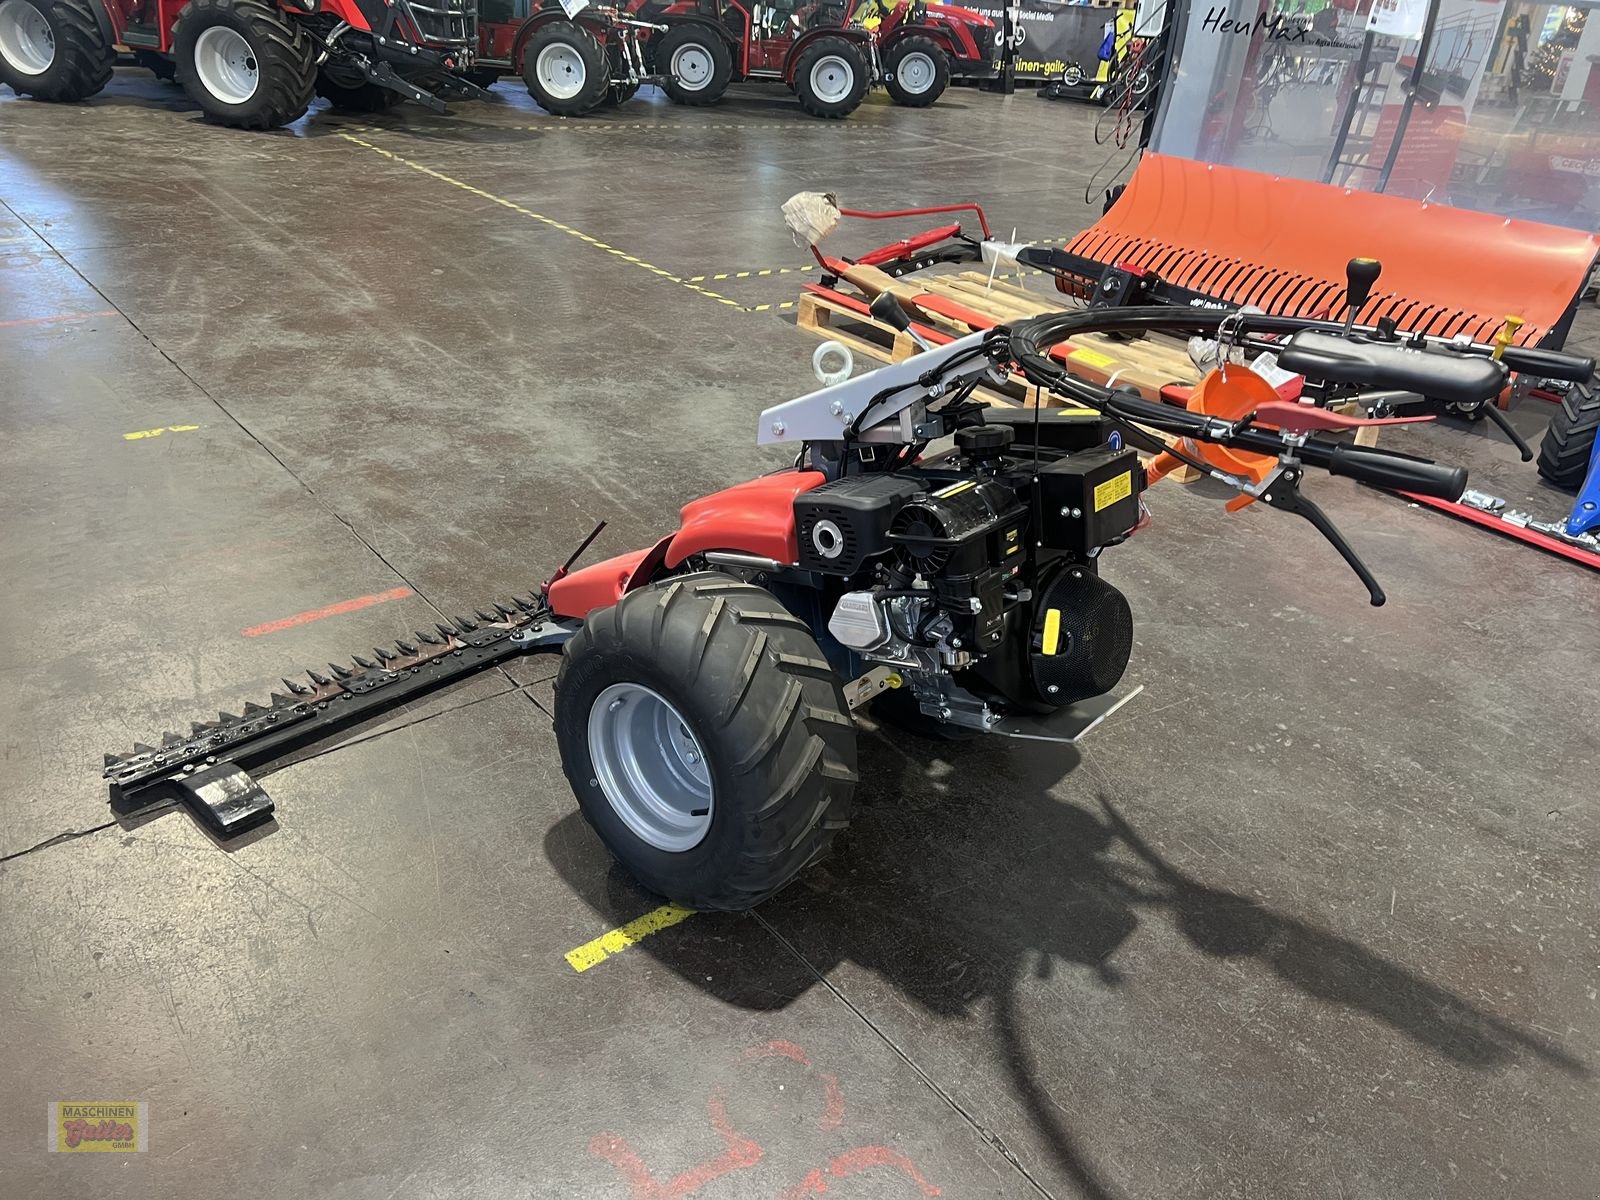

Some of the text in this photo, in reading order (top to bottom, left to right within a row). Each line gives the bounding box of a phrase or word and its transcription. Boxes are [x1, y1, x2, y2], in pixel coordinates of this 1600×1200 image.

[1019, 10, 1036, 20] Social
[1036, 11, 1054, 22] Media
[1202, 6, 1309, 43] HeuMax
